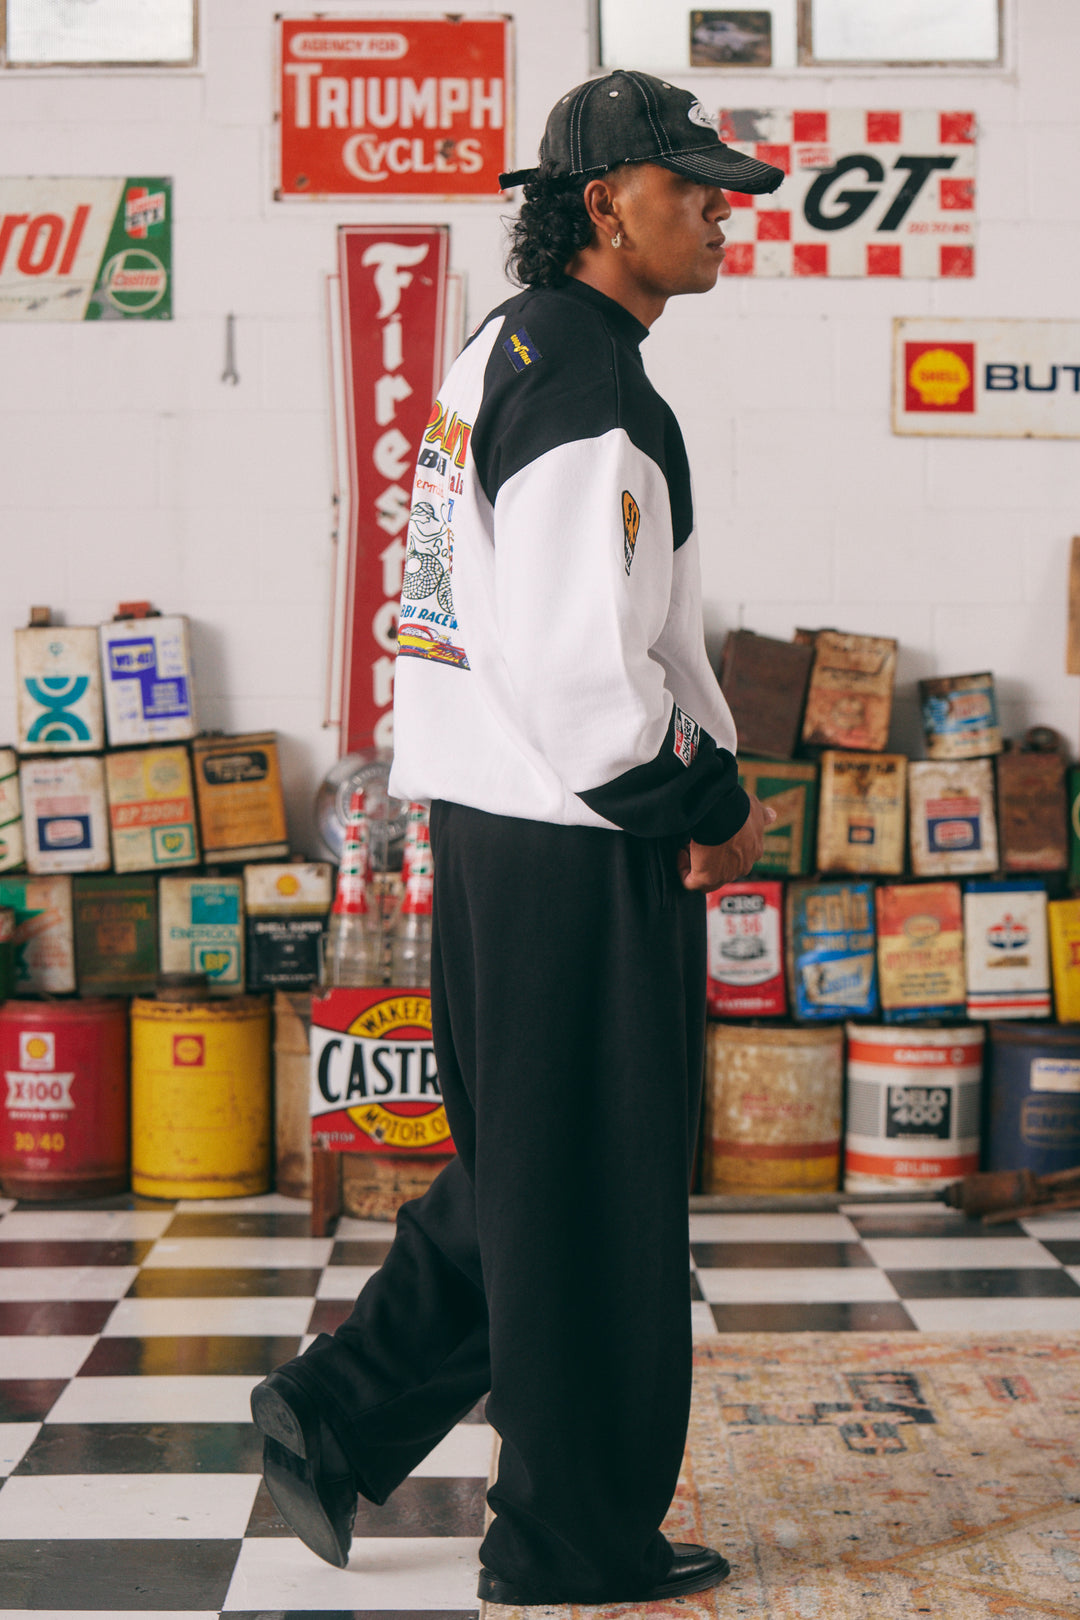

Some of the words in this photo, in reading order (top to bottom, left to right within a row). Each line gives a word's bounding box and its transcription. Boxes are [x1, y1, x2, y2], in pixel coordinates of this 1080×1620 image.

[301, 37, 363, 51] AGENCY
[369, 38, 398, 51] FOR
[285, 63, 503, 129] TRIUMPH
[342, 134, 483, 182] CYCLES
[803, 154, 957, 232] GT
[919, 370, 961, 382] SHELL
[682, 718, 692, 761] CHANGER
[721, 895, 763, 912] CRC
[170, 927, 237, 940] ENERGOL
[256, 923, 287, 934] SHELL
[205, 953, 230, 971] BP
[893, 1048, 947, 1065] CALTEX
[890, 1084, 948, 1108] DELO
[364, 1109, 427, 1141] MOTOR
[892, 1105, 943, 1126] 400
